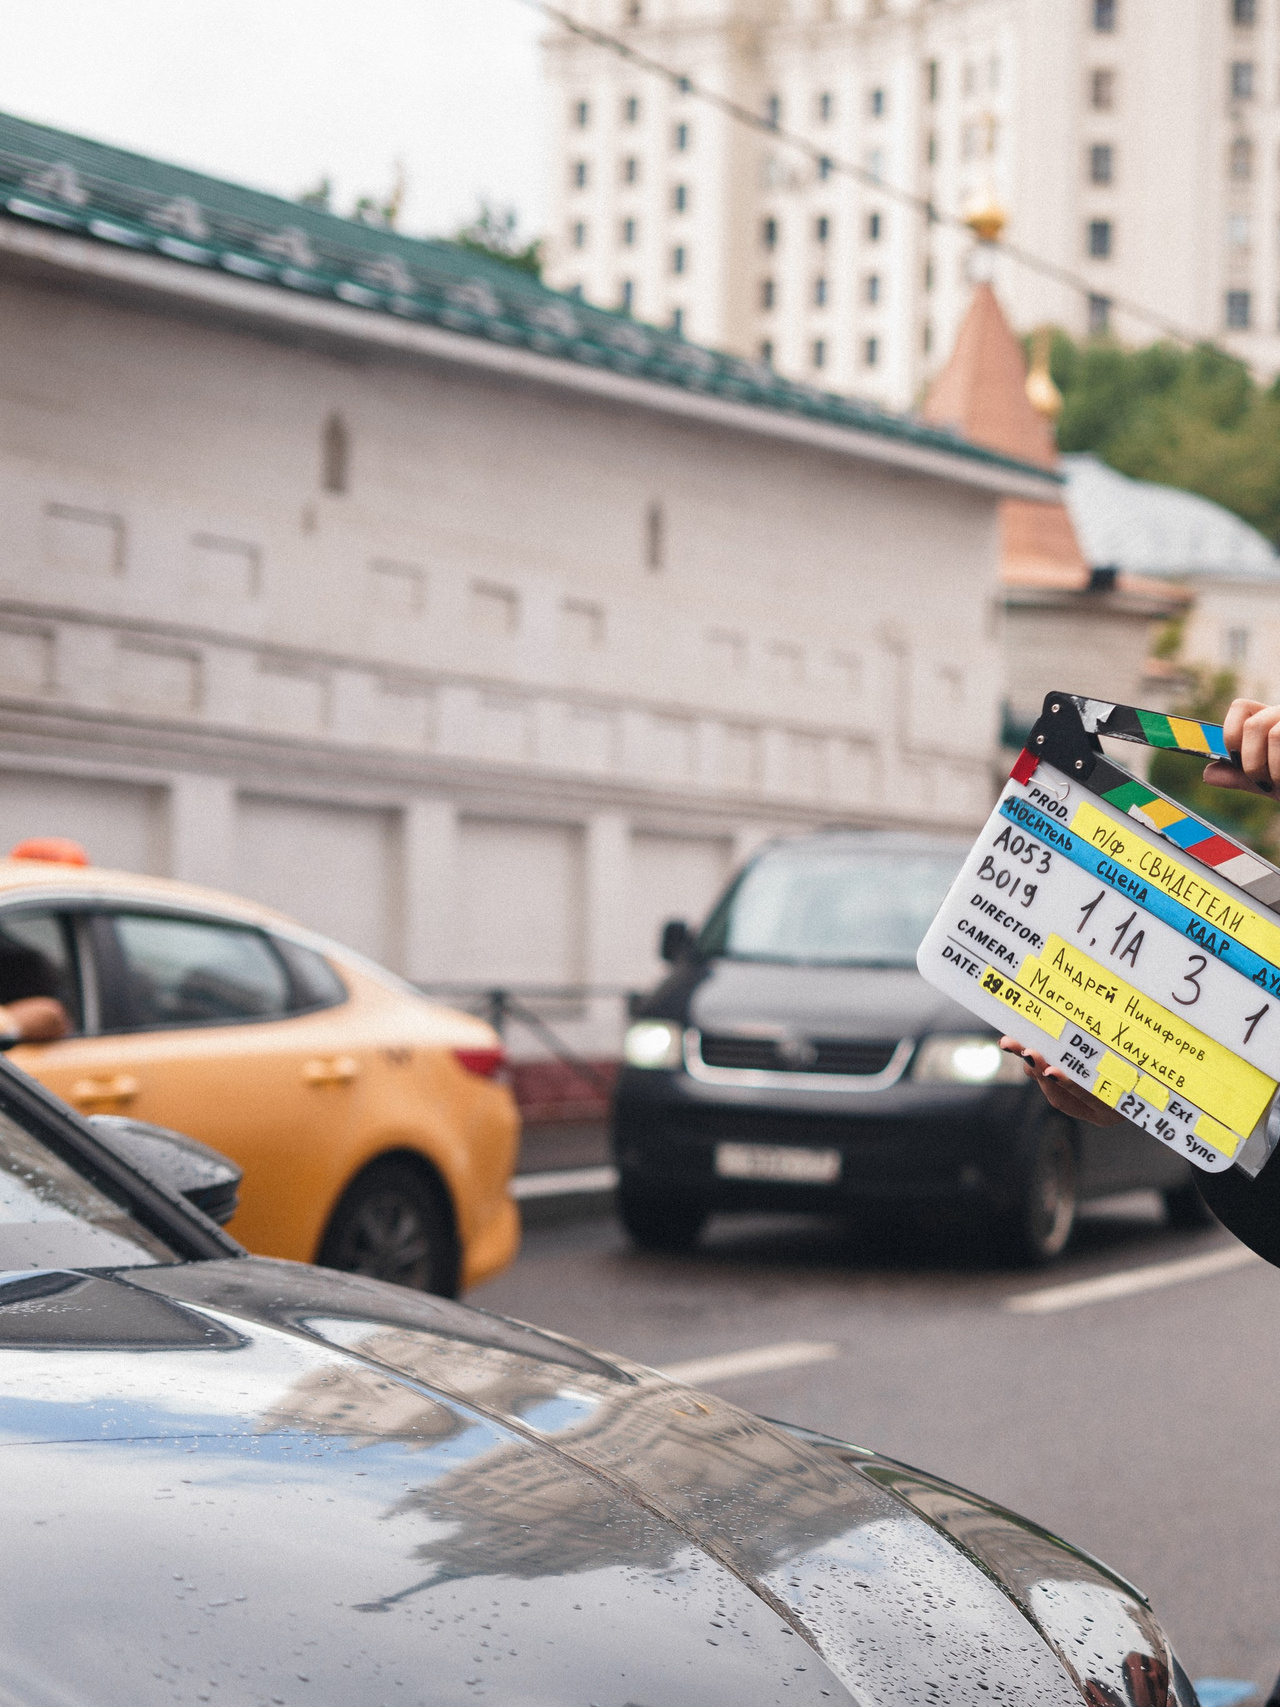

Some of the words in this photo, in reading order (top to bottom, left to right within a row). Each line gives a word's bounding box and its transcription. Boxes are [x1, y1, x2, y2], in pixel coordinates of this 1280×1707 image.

[1028, 787, 1068, 822] PROD.
[970, 893, 1044, 949] DIRECTOR:
[1185, 917, 1230, 956] КАДР
[957, 919, 1019, 969] CAMERA:
[941, 945, 982, 979] DATE:
[1171, 954, 1207, 1006] 3
[1244, 1003, 1270, 1045] 1
[1069, 1033, 1099, 1059] Day
[1167, 1101, 1193, 1124] Ext
[1185, 1134, 1217, 1163] Sync
